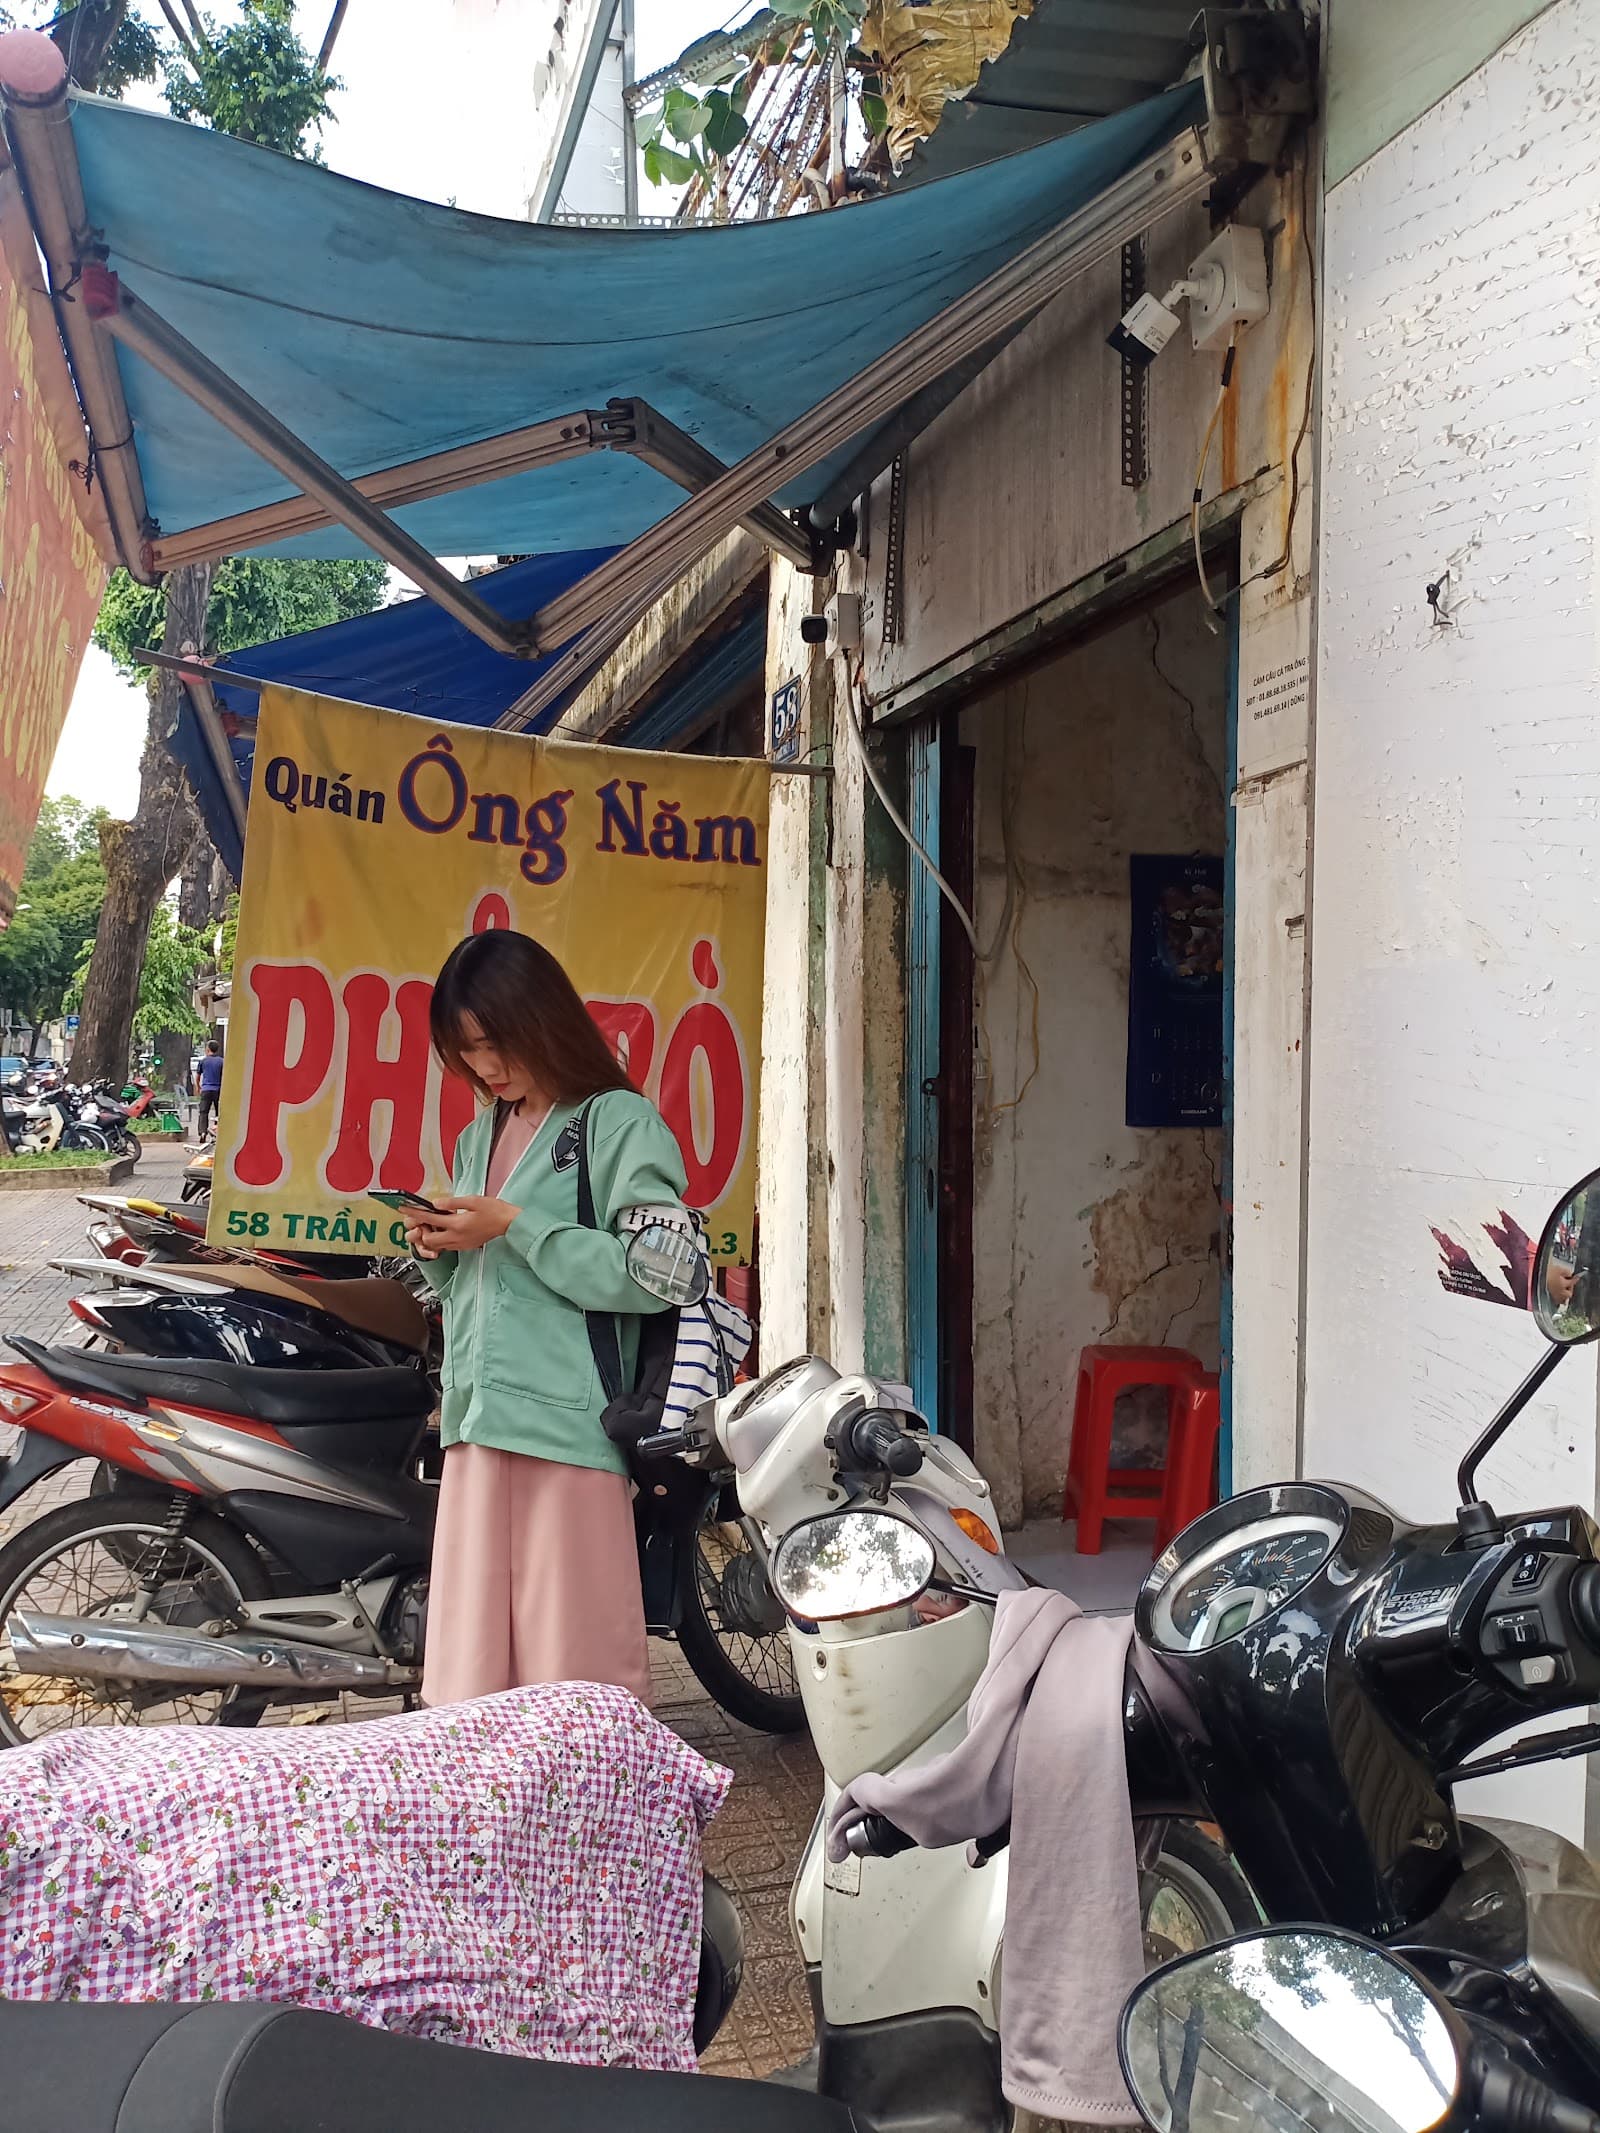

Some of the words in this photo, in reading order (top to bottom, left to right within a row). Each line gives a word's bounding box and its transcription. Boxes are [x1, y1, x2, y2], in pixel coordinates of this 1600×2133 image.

[775, 686, 797, 739] 58
[264, 756, 386, 824] Quán
[398, 733, 575, 886] Ông
[595, 778, 762, 867] Năm
[226, 1210, 270, 1237] 58
[282, 1207, 377, 1244] TRẦN
[1265, 1540, 1280, 1549] 80
[1291, 1535, 1307, 1545] 100
[1307, 1547, 1323, 1557] 120
[1295, 1572, 1312, 1582] 140
[1186, 1588, 1200, 1598] 20
